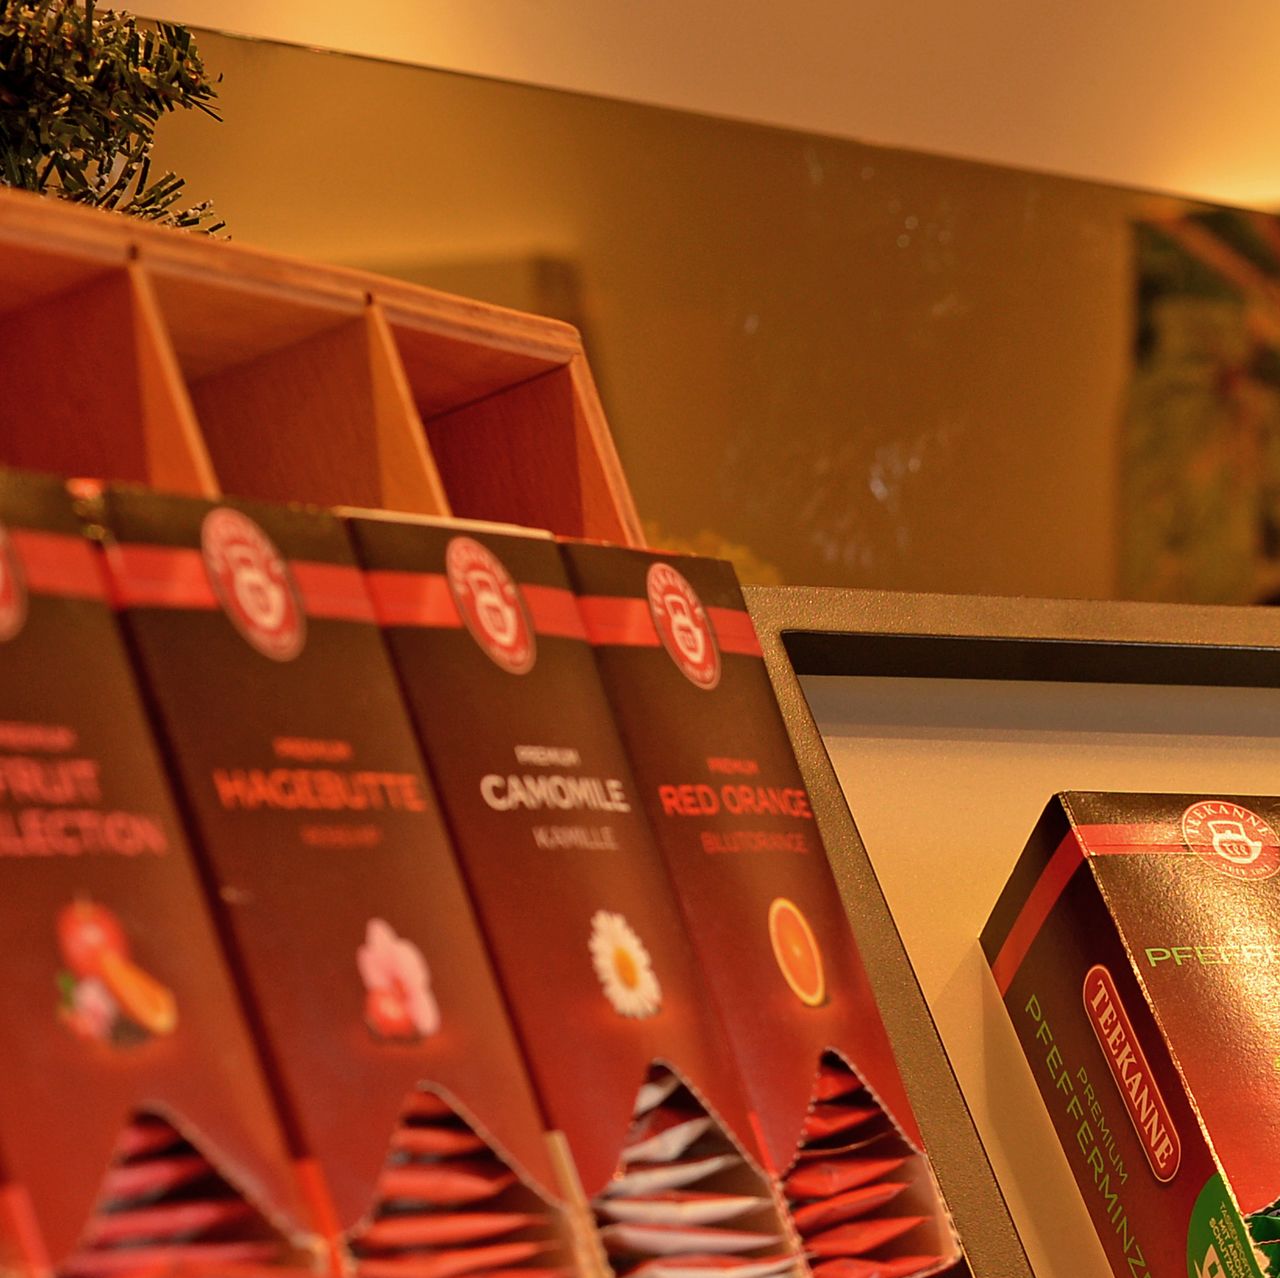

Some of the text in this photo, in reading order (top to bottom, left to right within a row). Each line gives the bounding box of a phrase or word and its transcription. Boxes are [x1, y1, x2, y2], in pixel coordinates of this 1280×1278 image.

[480, 773, 630, 814] CAMOMILE
[659, 784, 812, 820] RED ORANGE
[1186, 805, 1270, 835] TEEKANNE
[1091, 979, 1173, 1169] TEEKANNE
[1078, 1066, 1128, 1185] PREMIUM
